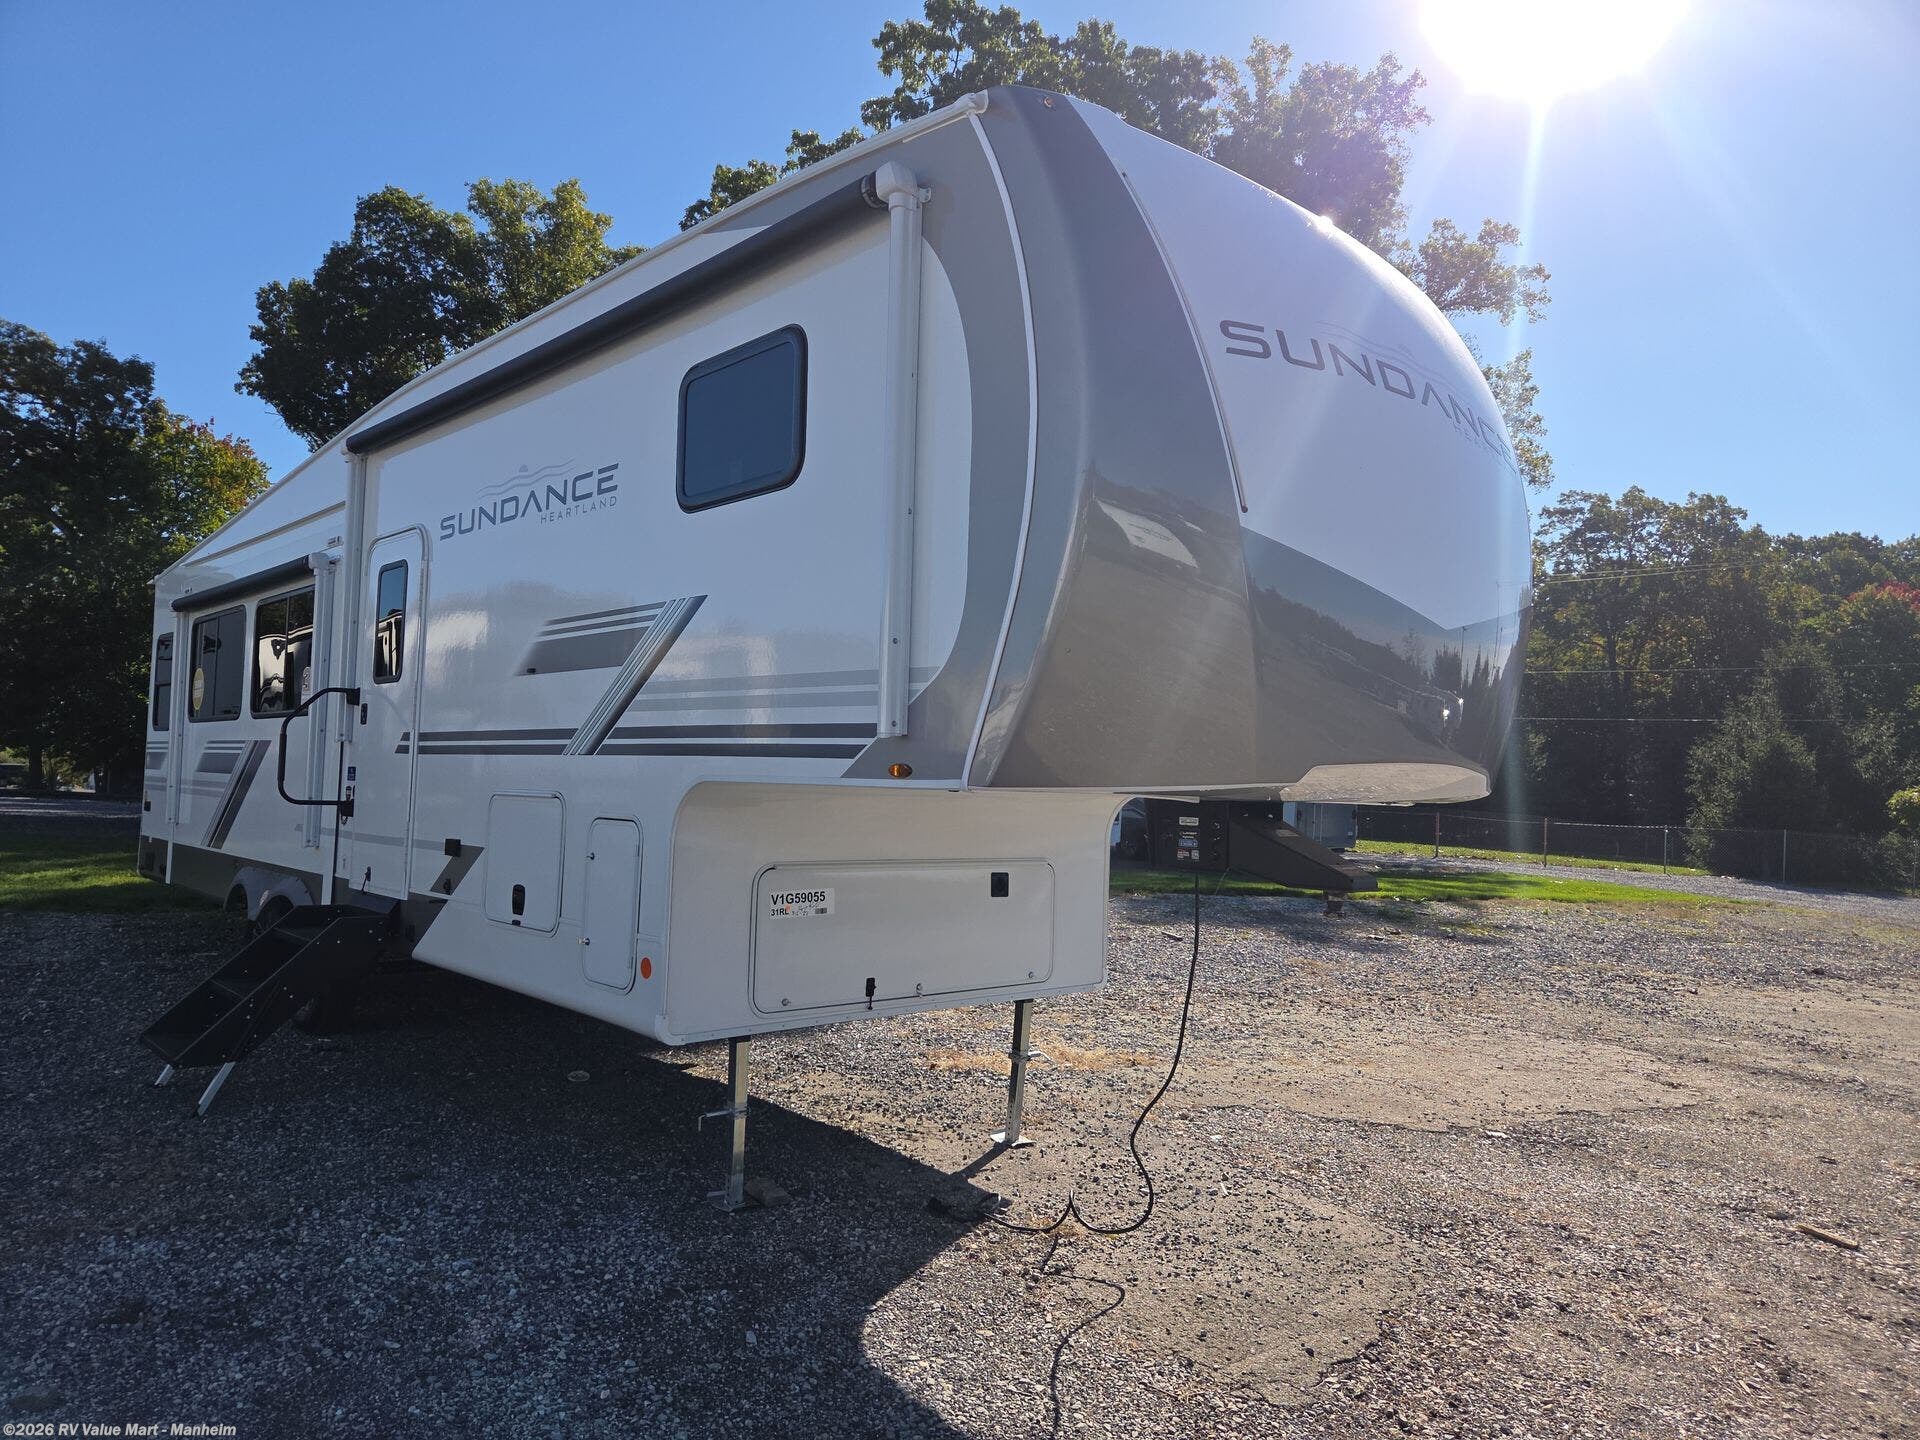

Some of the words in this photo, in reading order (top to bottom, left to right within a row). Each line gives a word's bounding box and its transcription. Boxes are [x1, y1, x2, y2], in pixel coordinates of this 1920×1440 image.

[1220, 320, 1517, 474] SUNDANCE
[440, 463, 619, 541] SUNDANCE
[540, 496, 618, 525] HEARTLAND
[771, 891, 826, 905] V1G59055
